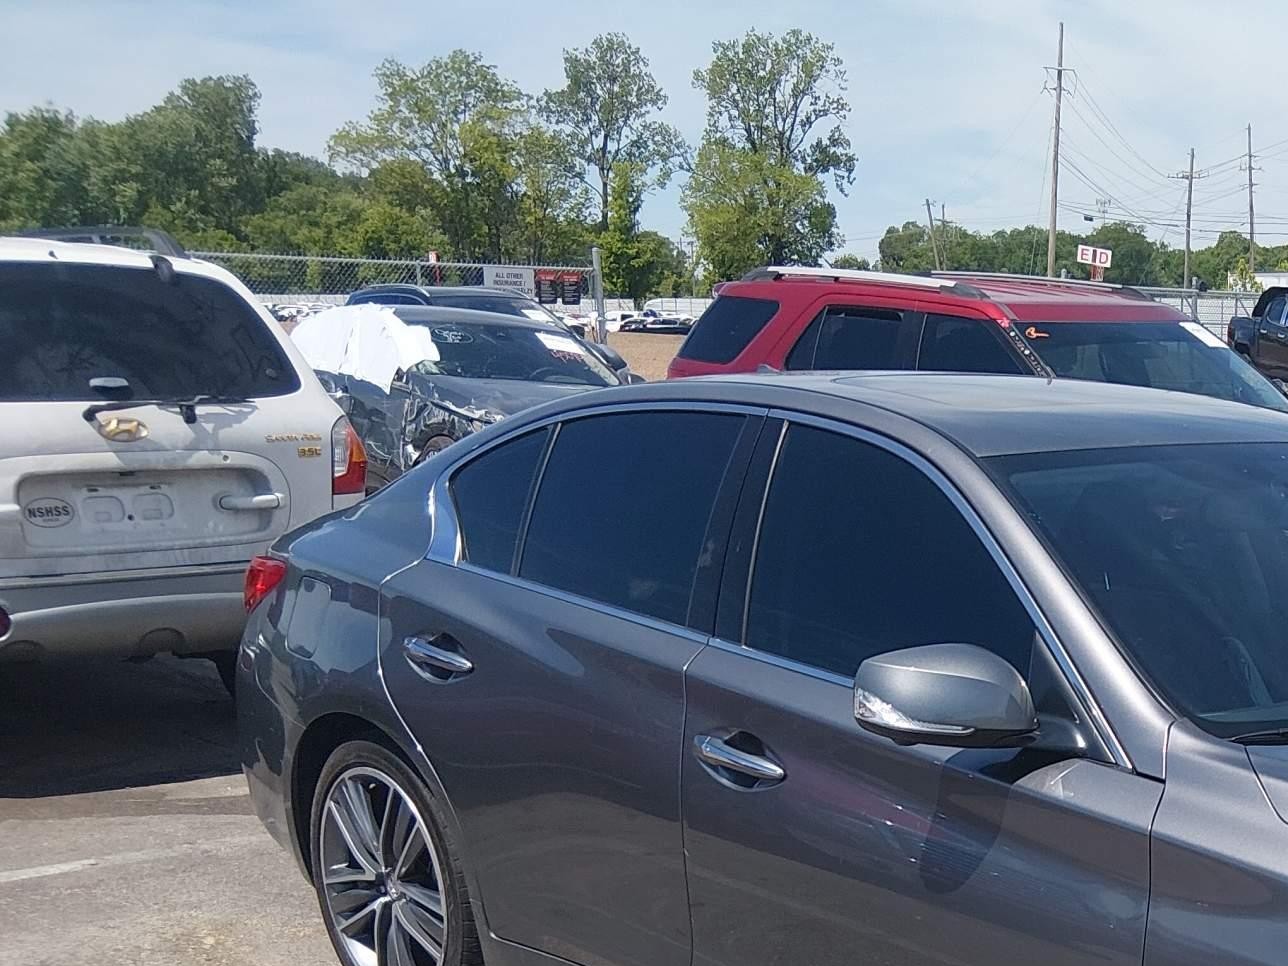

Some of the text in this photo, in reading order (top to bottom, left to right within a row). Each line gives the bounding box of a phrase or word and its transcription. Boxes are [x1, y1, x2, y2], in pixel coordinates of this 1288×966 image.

[506, 272, 524, 280] OTHER
[493, 279, 522, 287] INSURANCE
[27, 505, 71, 519] NSHSS
